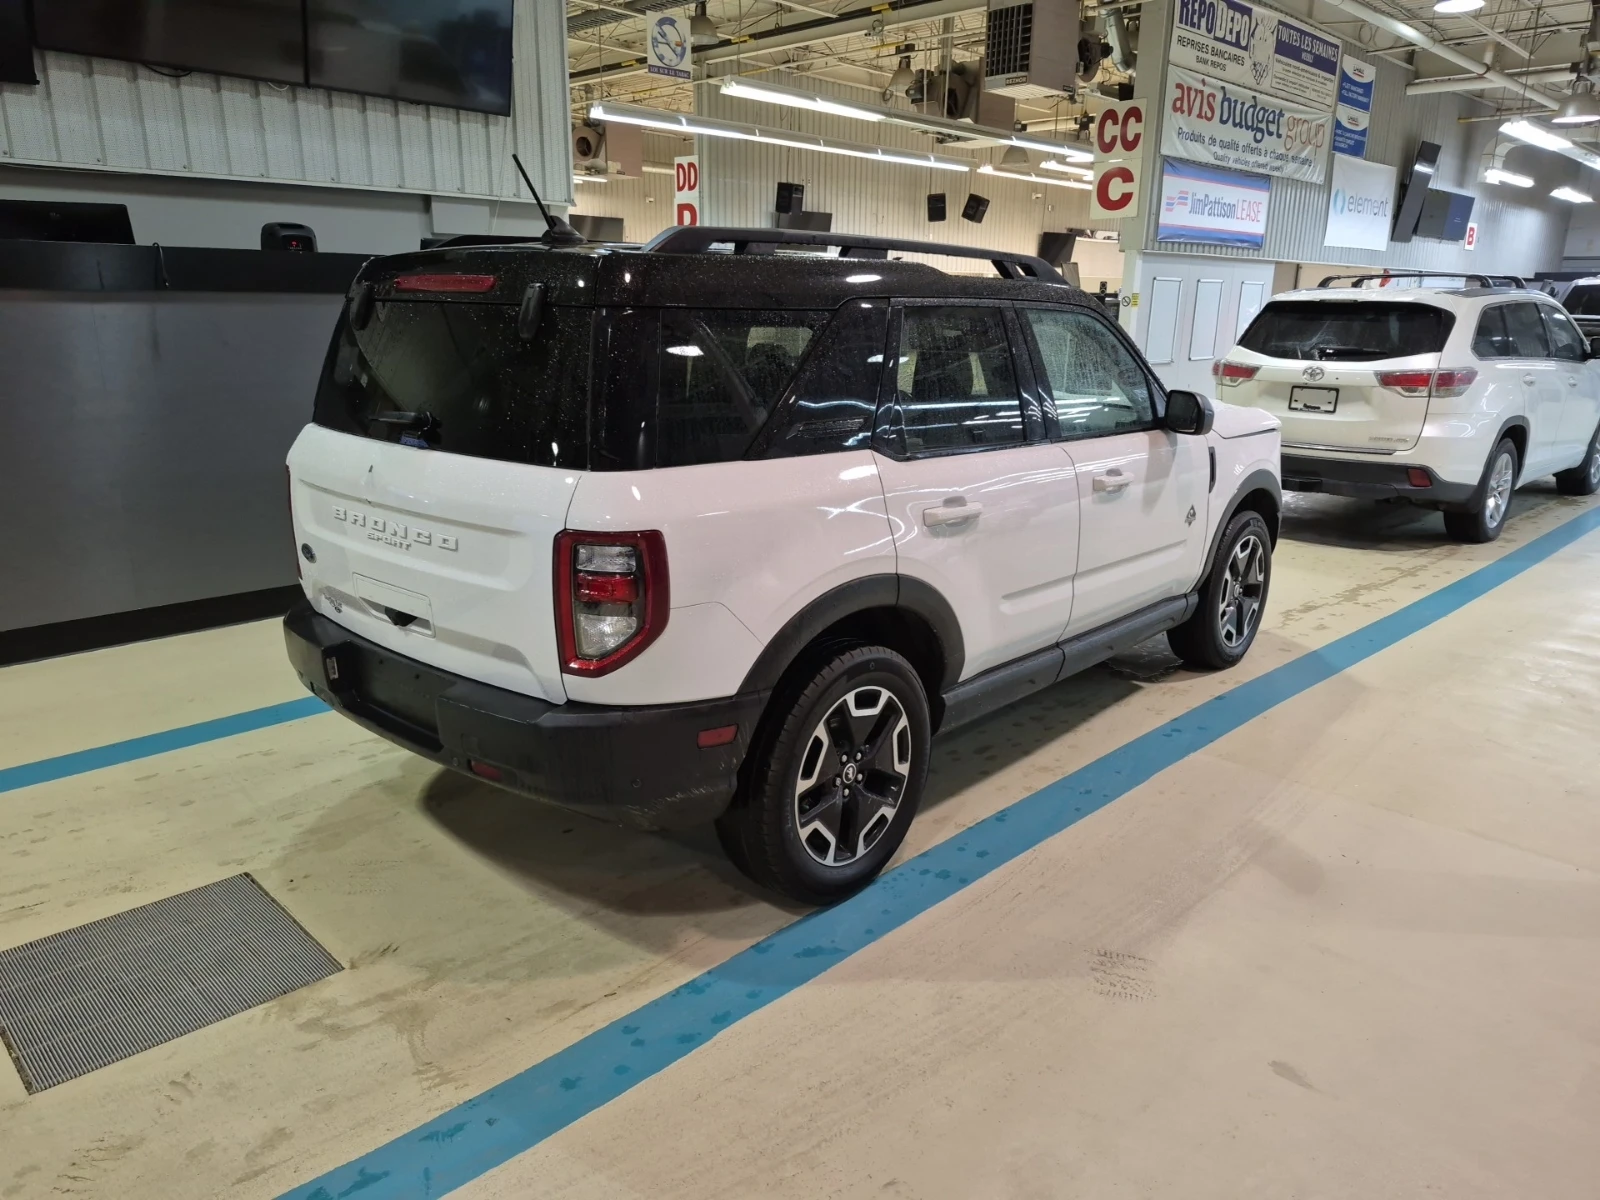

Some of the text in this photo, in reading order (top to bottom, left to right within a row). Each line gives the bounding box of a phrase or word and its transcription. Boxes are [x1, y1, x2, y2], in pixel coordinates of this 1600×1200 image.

[1179, 0, 1250, 47] REPO DEPO
[1177, 35, 1246, 66] REPRISES BANCAIRES
[1279, 25, 1338, 62] TOUTES LES SEMAINES
[1196, 55, 1227, 72] BANK REPOS
[1097, 106, 1142, 153] CC
[1172, 78, 1325, 152] avis budget group
[1177, 126, 1206, 145] Produits
[1208, 134, 1217, 147] de
[1219, 138, 1240, 151] qualité
[1241, 142, 1263, 157] offerts
[1270, 149, 1289, 163] chaque
[1213, 151, 1231, 164] Quality
[676, 162, 698, 192] DD
[1096, 166, 1135, 211] C
[677, 203, 697, 227] D
[1347, 192, 1389, 218] element
[1466, 226, 1475, 246] B
[332, 505, 459, 552] BRONCO
[367, 531, 412, 551] SPORT
